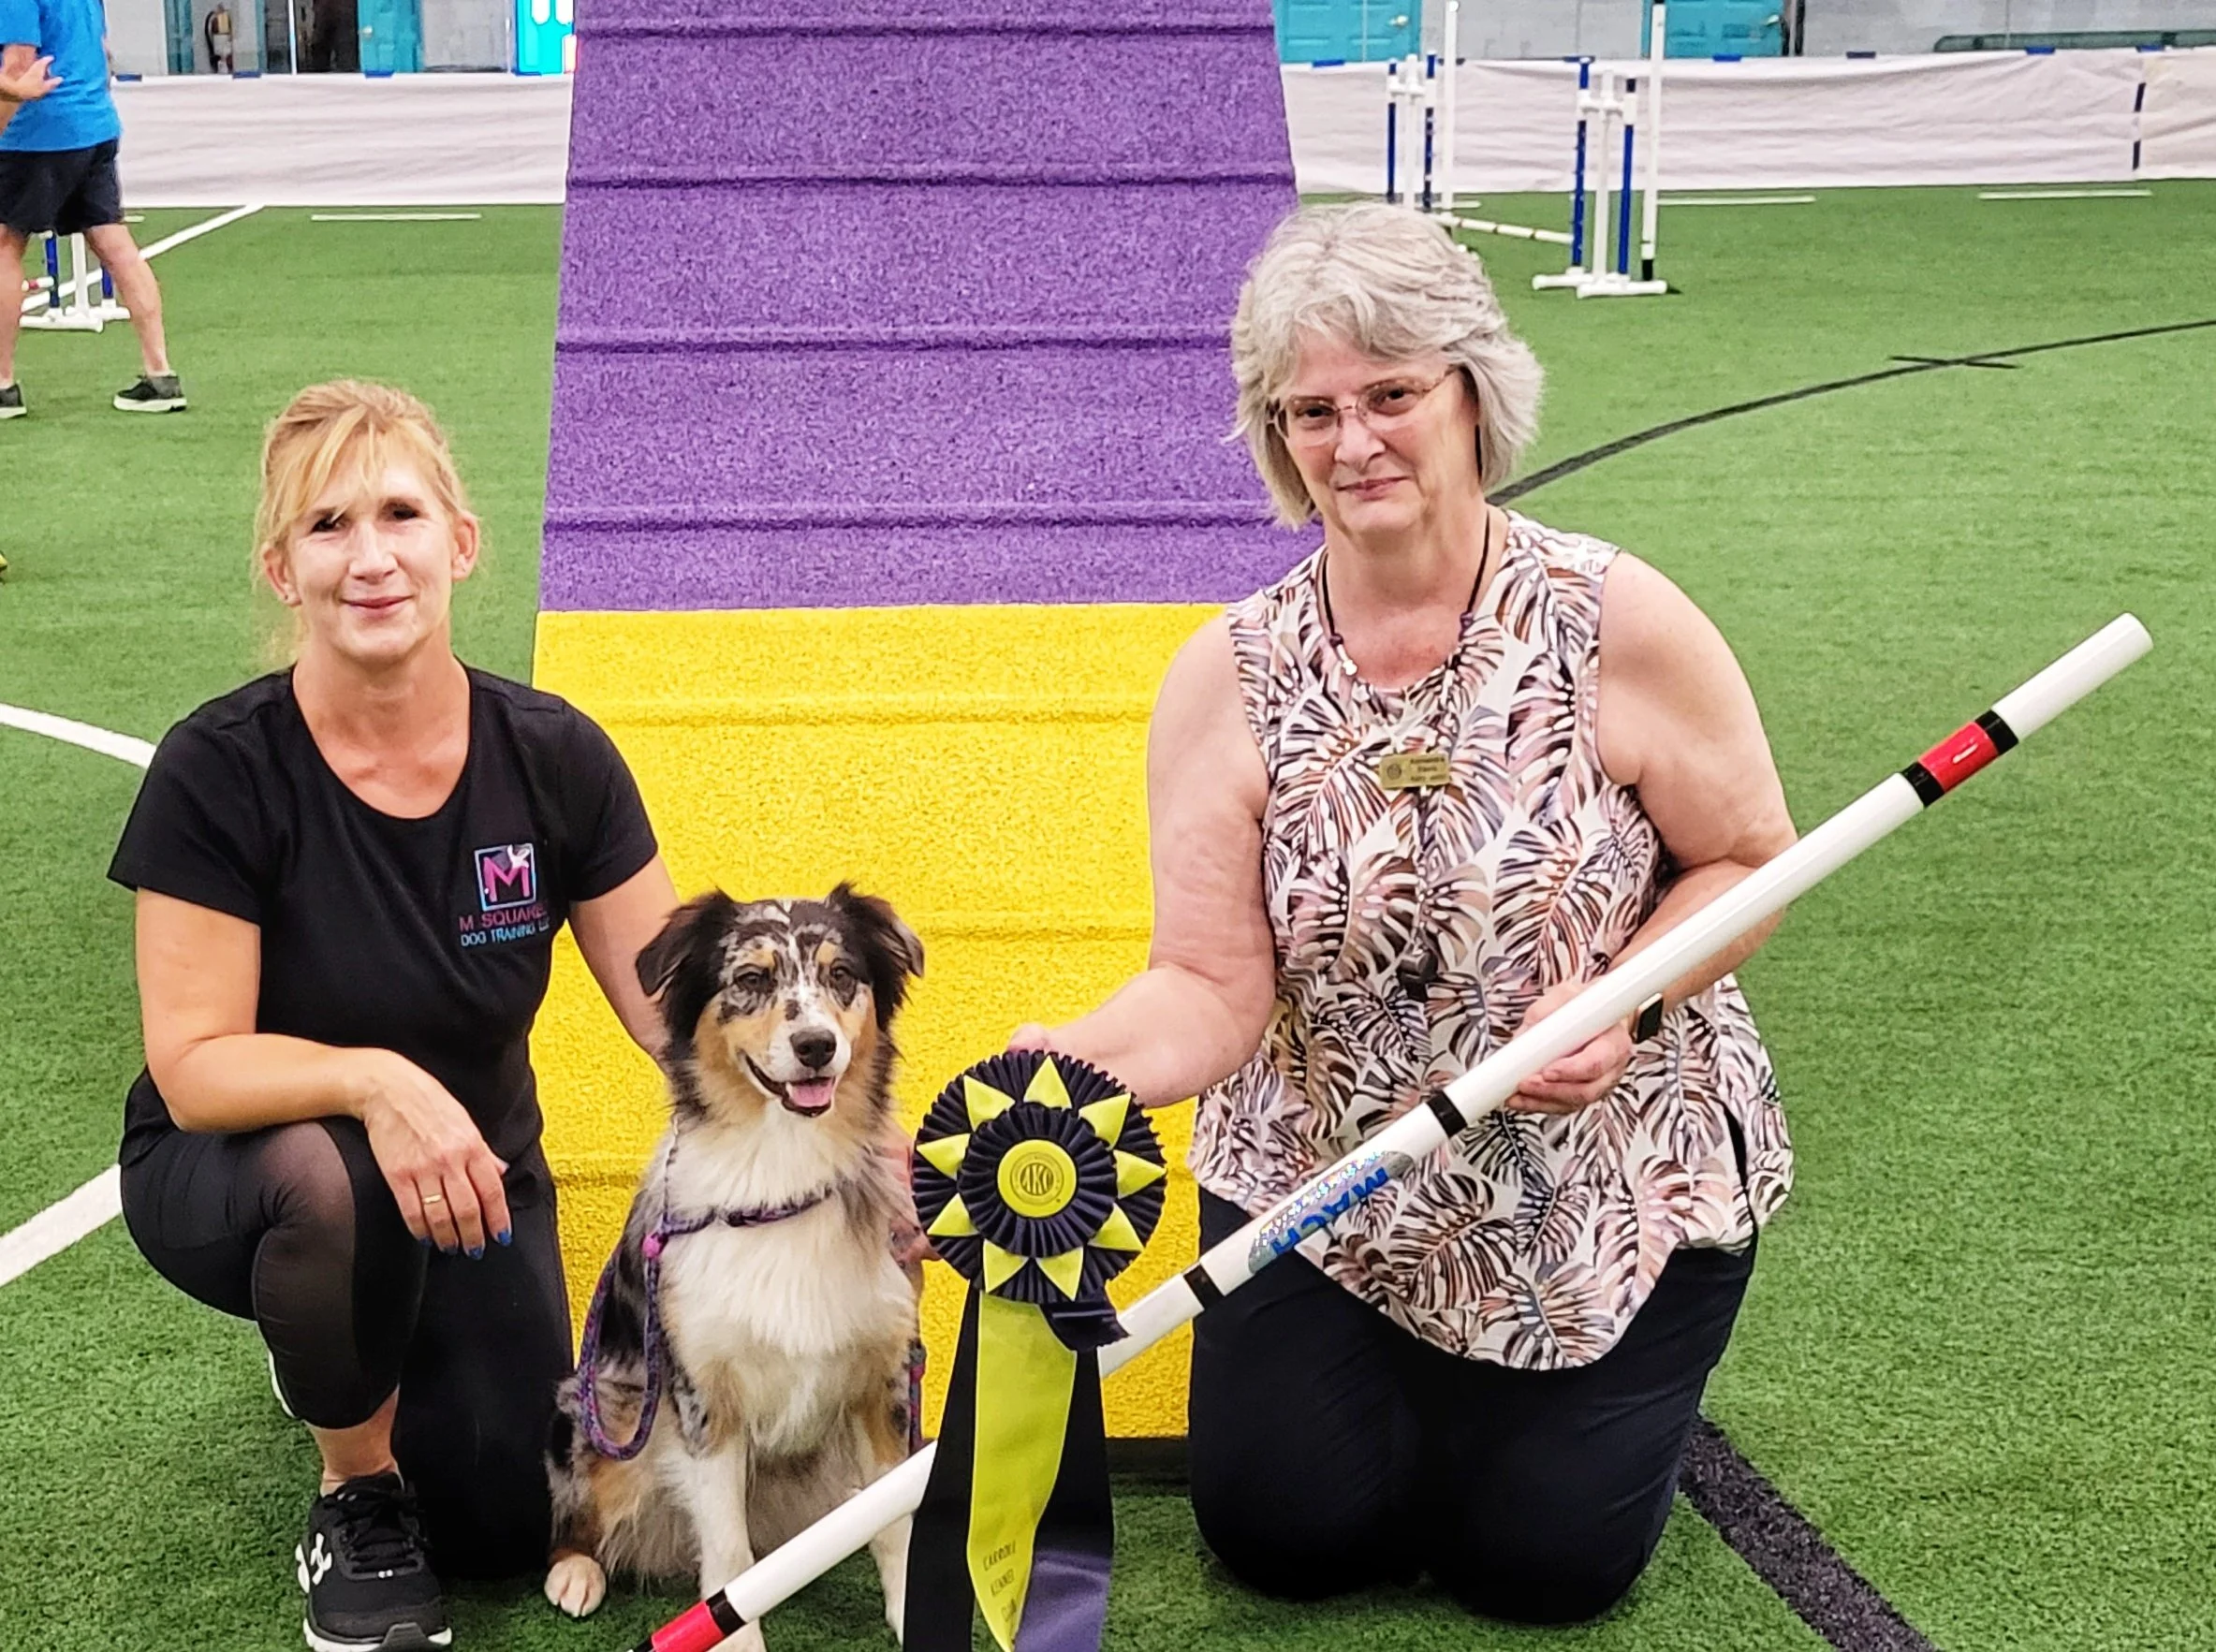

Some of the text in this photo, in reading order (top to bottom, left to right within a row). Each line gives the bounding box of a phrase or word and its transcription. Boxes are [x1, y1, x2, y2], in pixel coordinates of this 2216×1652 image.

[460, 915, 474, 931] M
[461, 931, 486, 946] DOG
[1021, 1164, 1053, 1195] AKC
